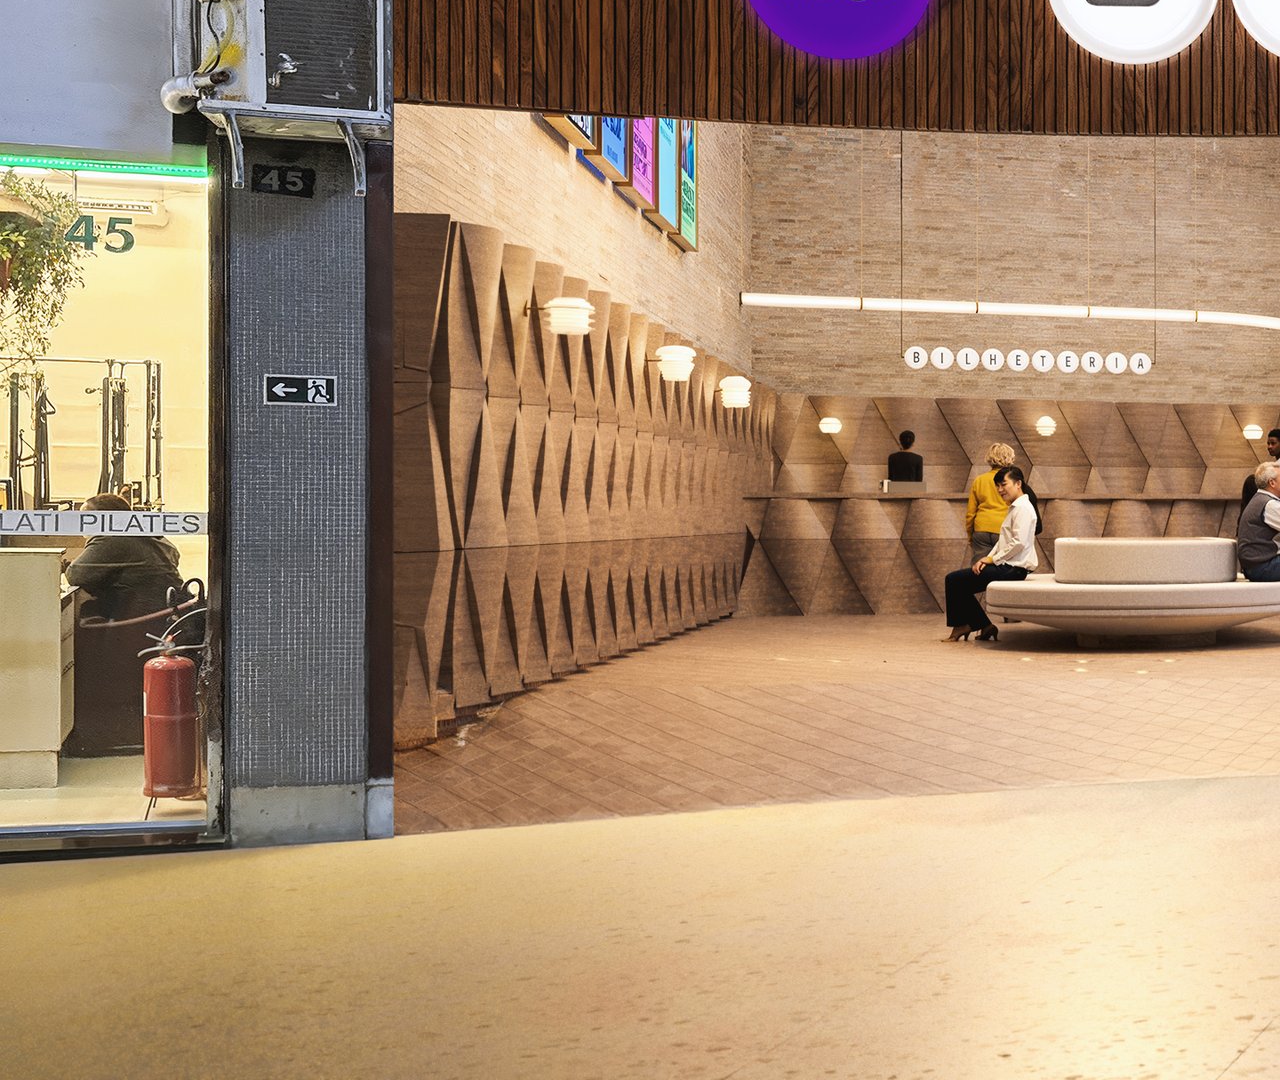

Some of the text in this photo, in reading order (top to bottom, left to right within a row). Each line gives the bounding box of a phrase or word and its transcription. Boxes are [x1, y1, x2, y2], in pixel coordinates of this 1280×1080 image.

[261, 170, 303, 191] 45
[64, 215, 135, 253] 45
[913, 351, 1144, 369] BILHETERIA
[0, 513, 200, 533] LATI PILATES
